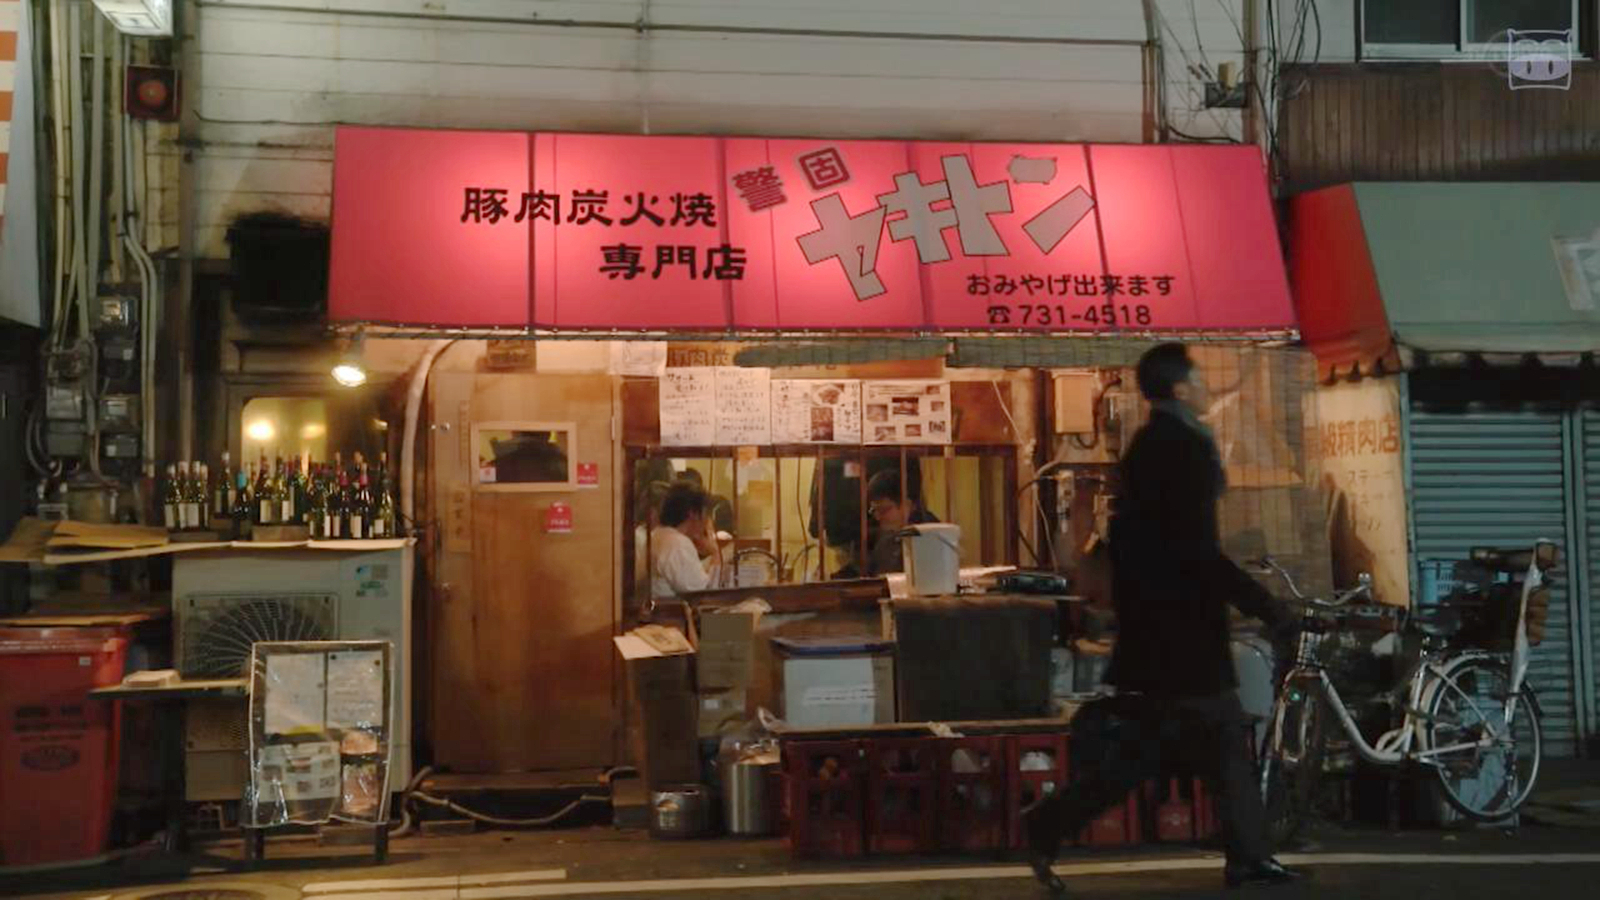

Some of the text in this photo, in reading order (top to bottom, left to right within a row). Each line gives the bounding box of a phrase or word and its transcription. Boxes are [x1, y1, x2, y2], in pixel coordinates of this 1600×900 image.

[732, 146, 850, 212] 警固
[460, 187, 718, 227] 豚肉炭火焼
[796, 154, 1096, 301] ヤキトン
[599, 243, 747, 280] 専門店
[966, 274, 1176, 298] おみやげ出来ます
[1020, 304, 1152, 326] 731-4518
